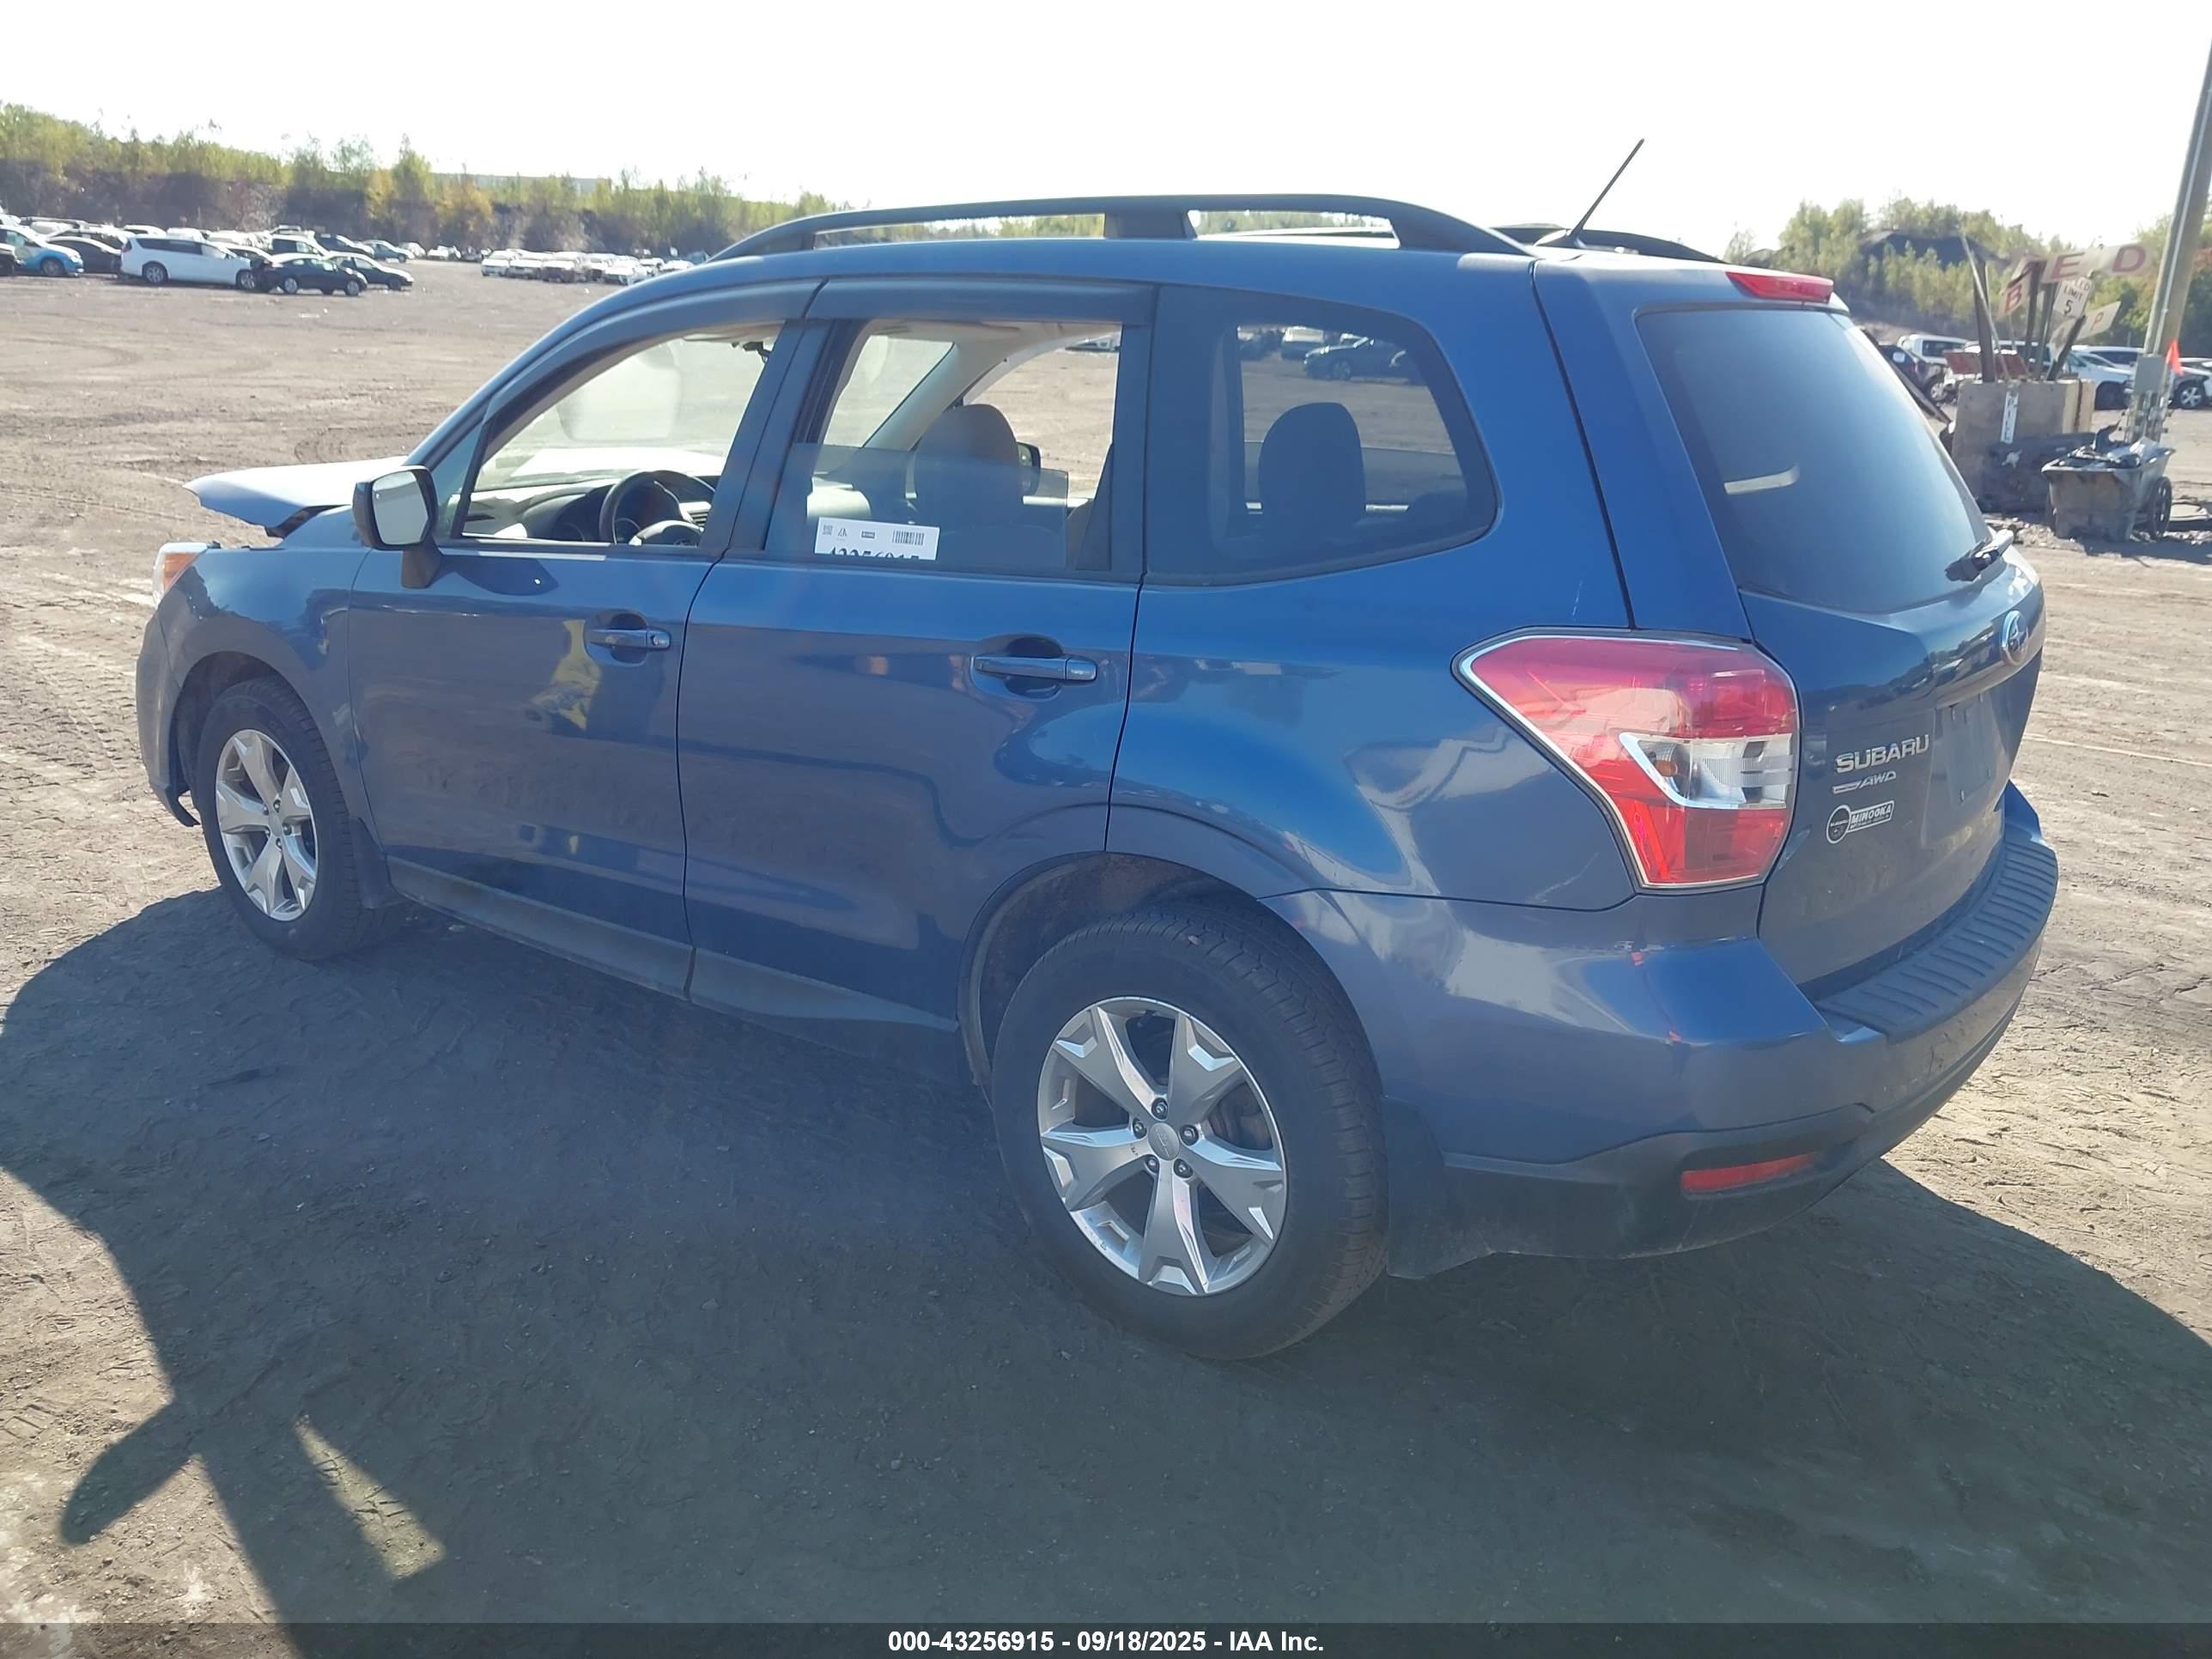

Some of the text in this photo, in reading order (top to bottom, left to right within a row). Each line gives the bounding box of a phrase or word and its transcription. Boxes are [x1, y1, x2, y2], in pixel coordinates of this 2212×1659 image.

[2112, 246, 2146, 272] D
[2063, 285, 2083, 301] LIMIT
[2063, 300, 2073, 315] 5
[1836, 734, 1929, 773] SUBARU
[1859, 770, 1896, 789] AWD
